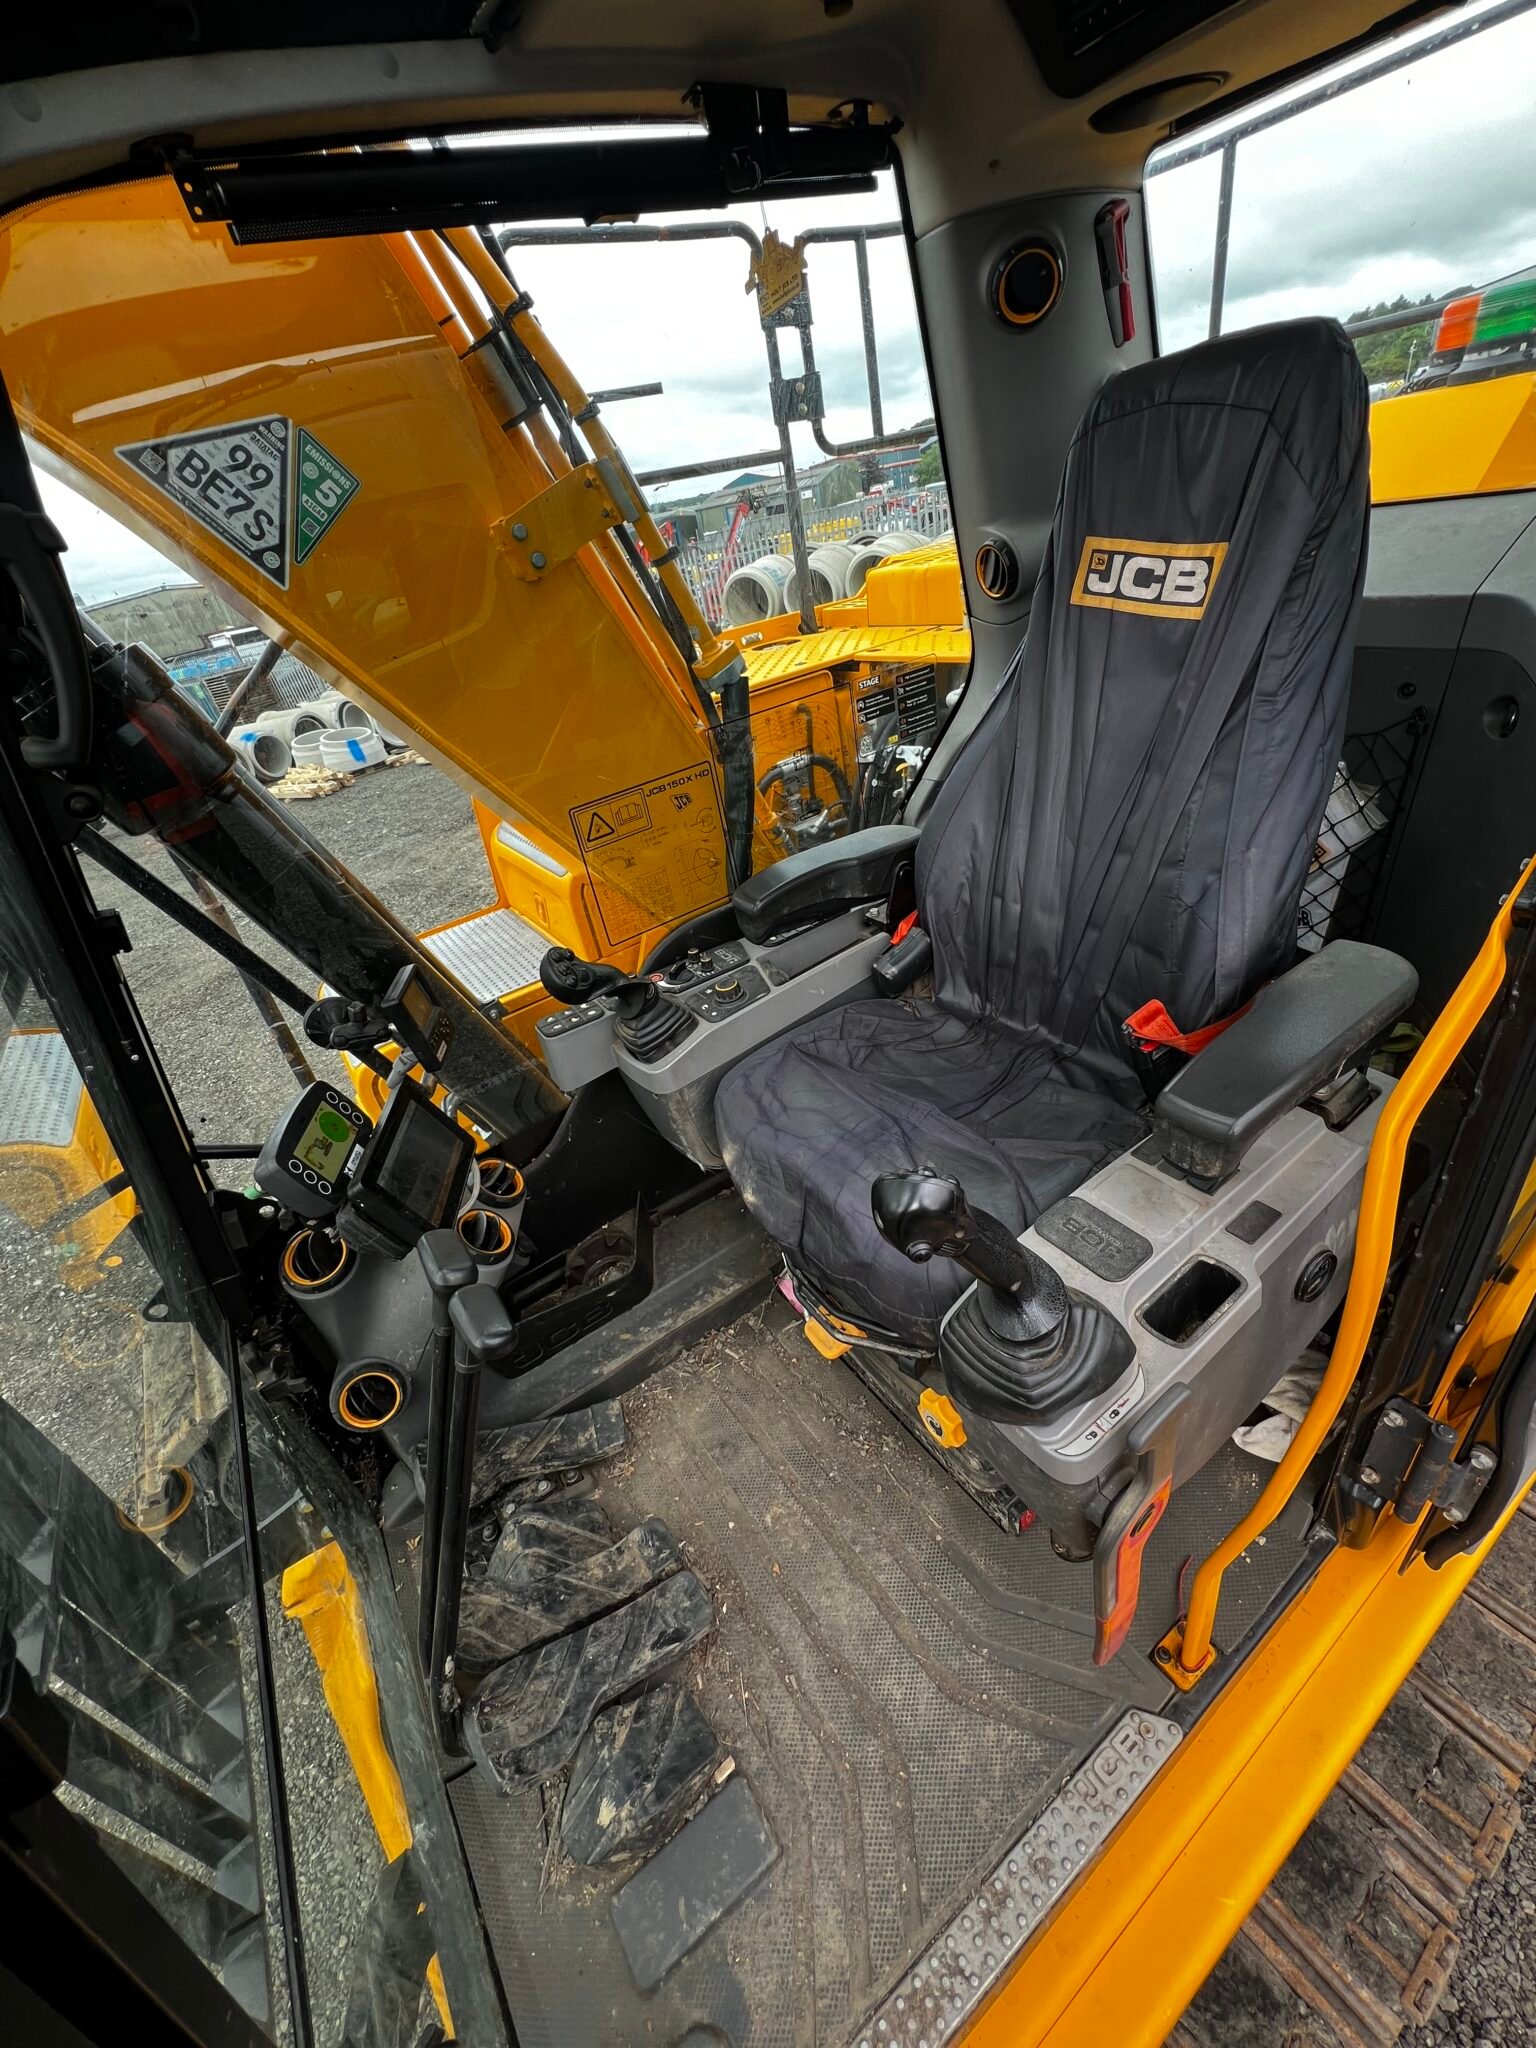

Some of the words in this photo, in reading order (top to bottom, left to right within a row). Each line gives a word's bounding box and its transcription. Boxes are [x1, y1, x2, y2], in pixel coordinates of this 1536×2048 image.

[251, 436, 279, 461] DATATAG
[259, 425, 285, 451] WARNING
[221, 444, 273, 491] 99
[175, 448, 273, 541] BE7S
[315, 479, 342, 508] 5
[1087, 554, 1209, 603] JCB
[859, 676, 879, 689] STAGE
[695, 768, 710, 780] HD
[674, 794, 691, 810] JCB
[715, 948, 738, 964] JCB
[1074, 1725, 1145, 1812] JCB
